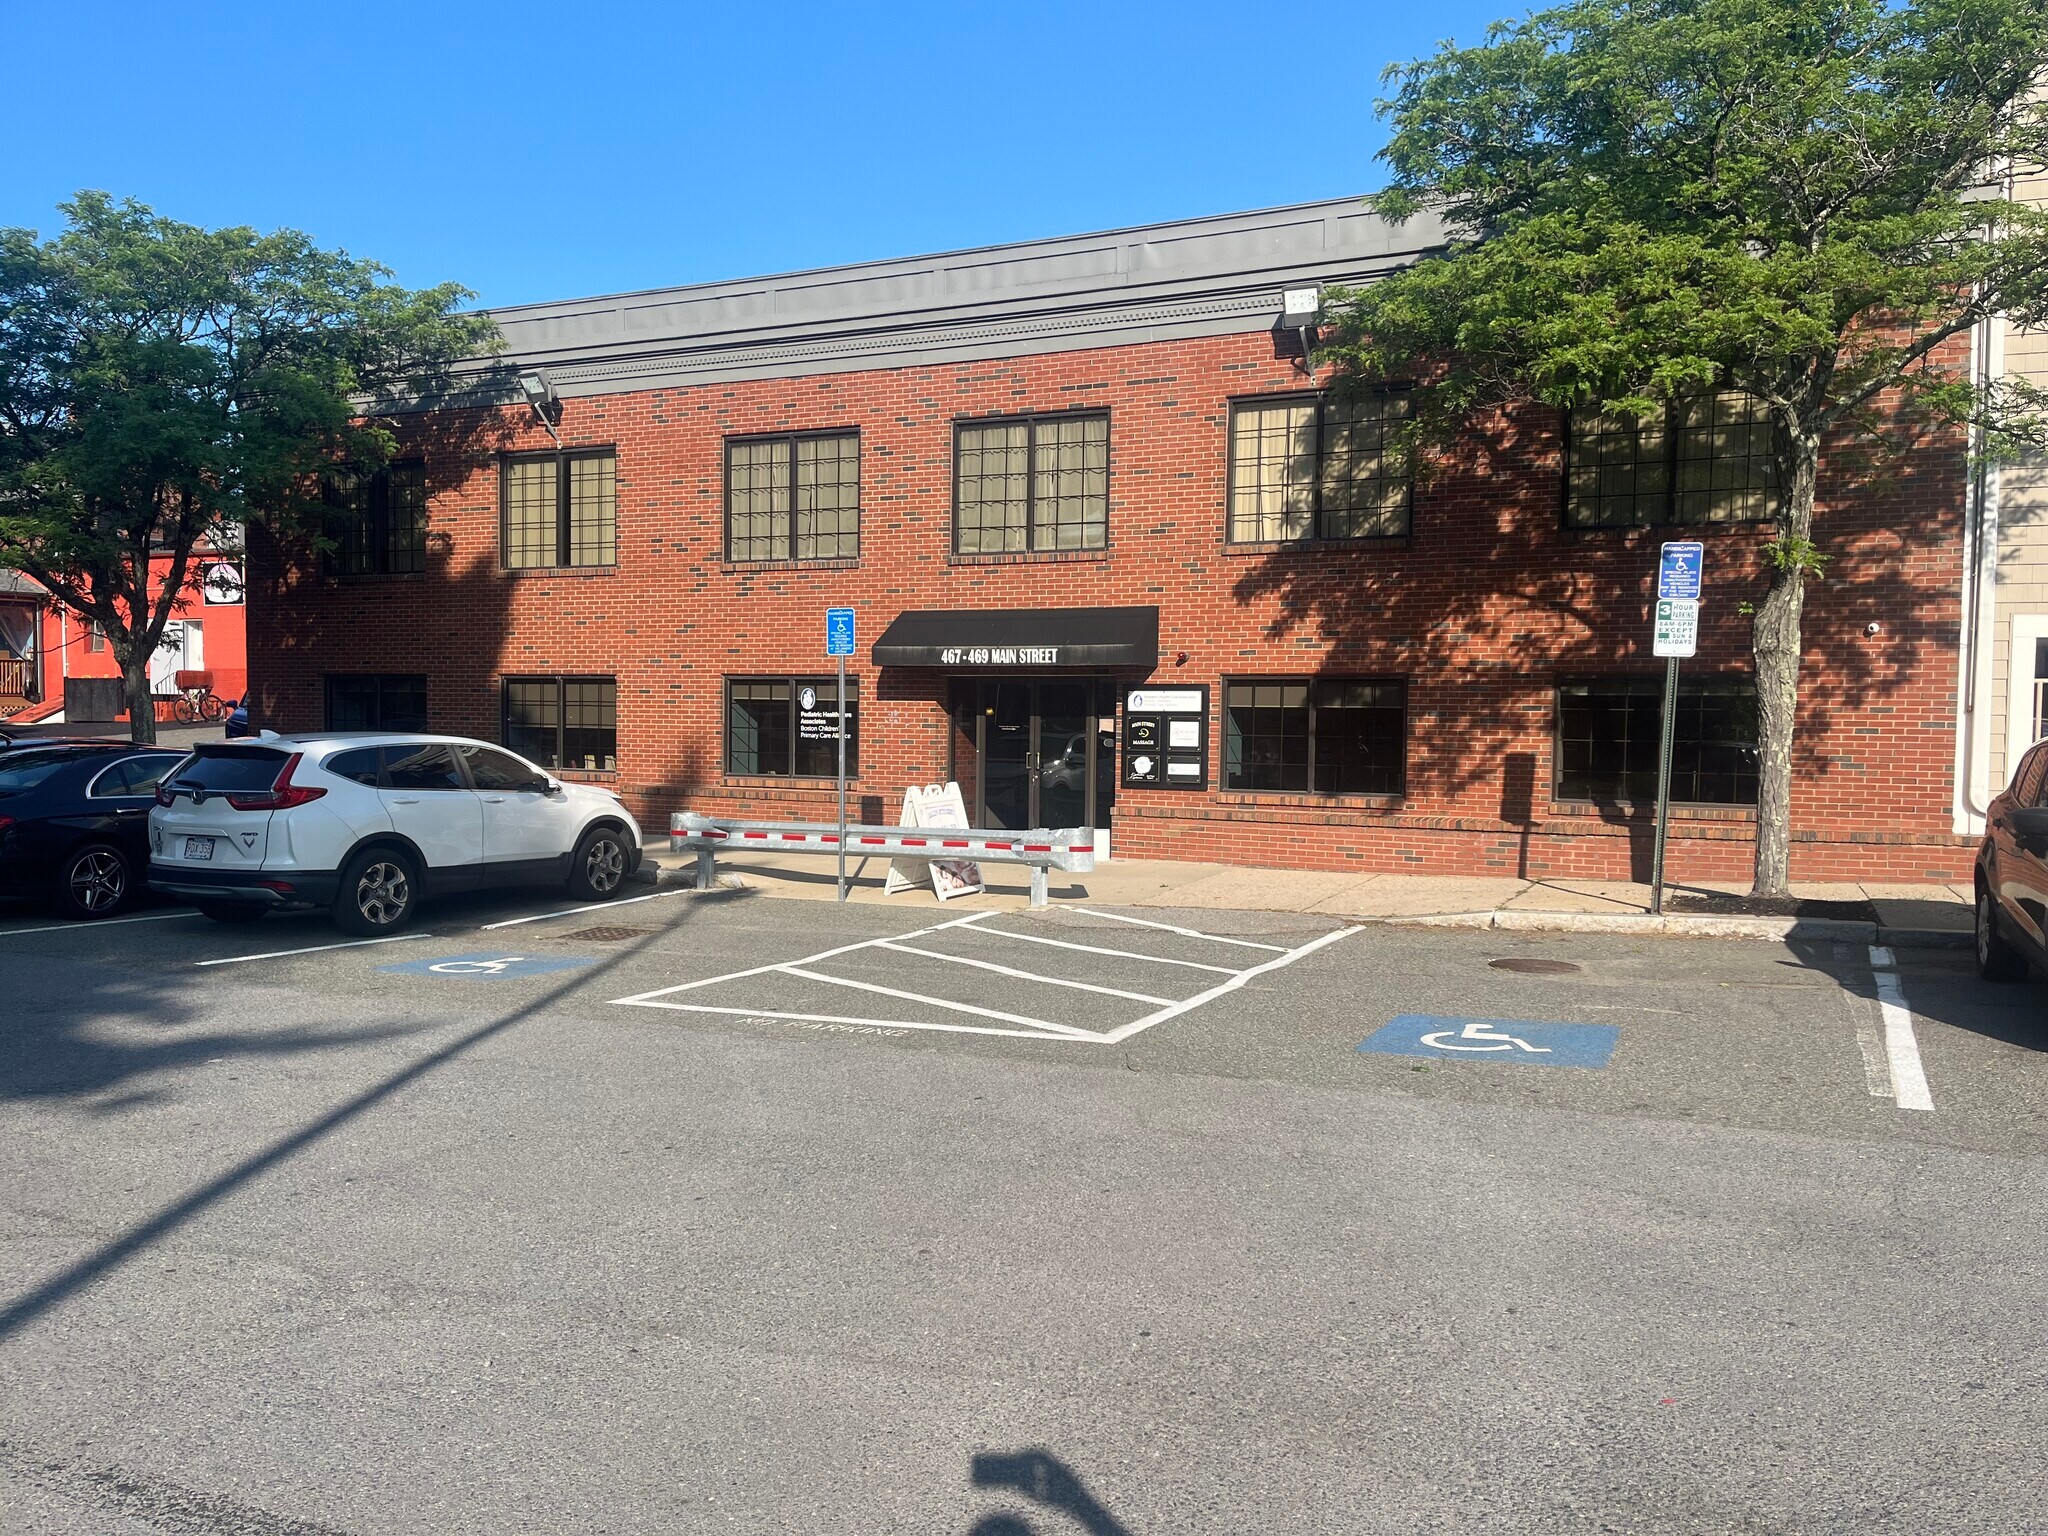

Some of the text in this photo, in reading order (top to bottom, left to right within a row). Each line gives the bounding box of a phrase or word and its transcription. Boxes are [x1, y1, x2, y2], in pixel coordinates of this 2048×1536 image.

[1659, 604, 1671, 616] 3
[1672, 611, 1694, 619] PARKING
[991, 648, 1017, 664] MAIN
[1019, 648, 1058, 664] STREET
[800, 732, 819, 740] Primary
